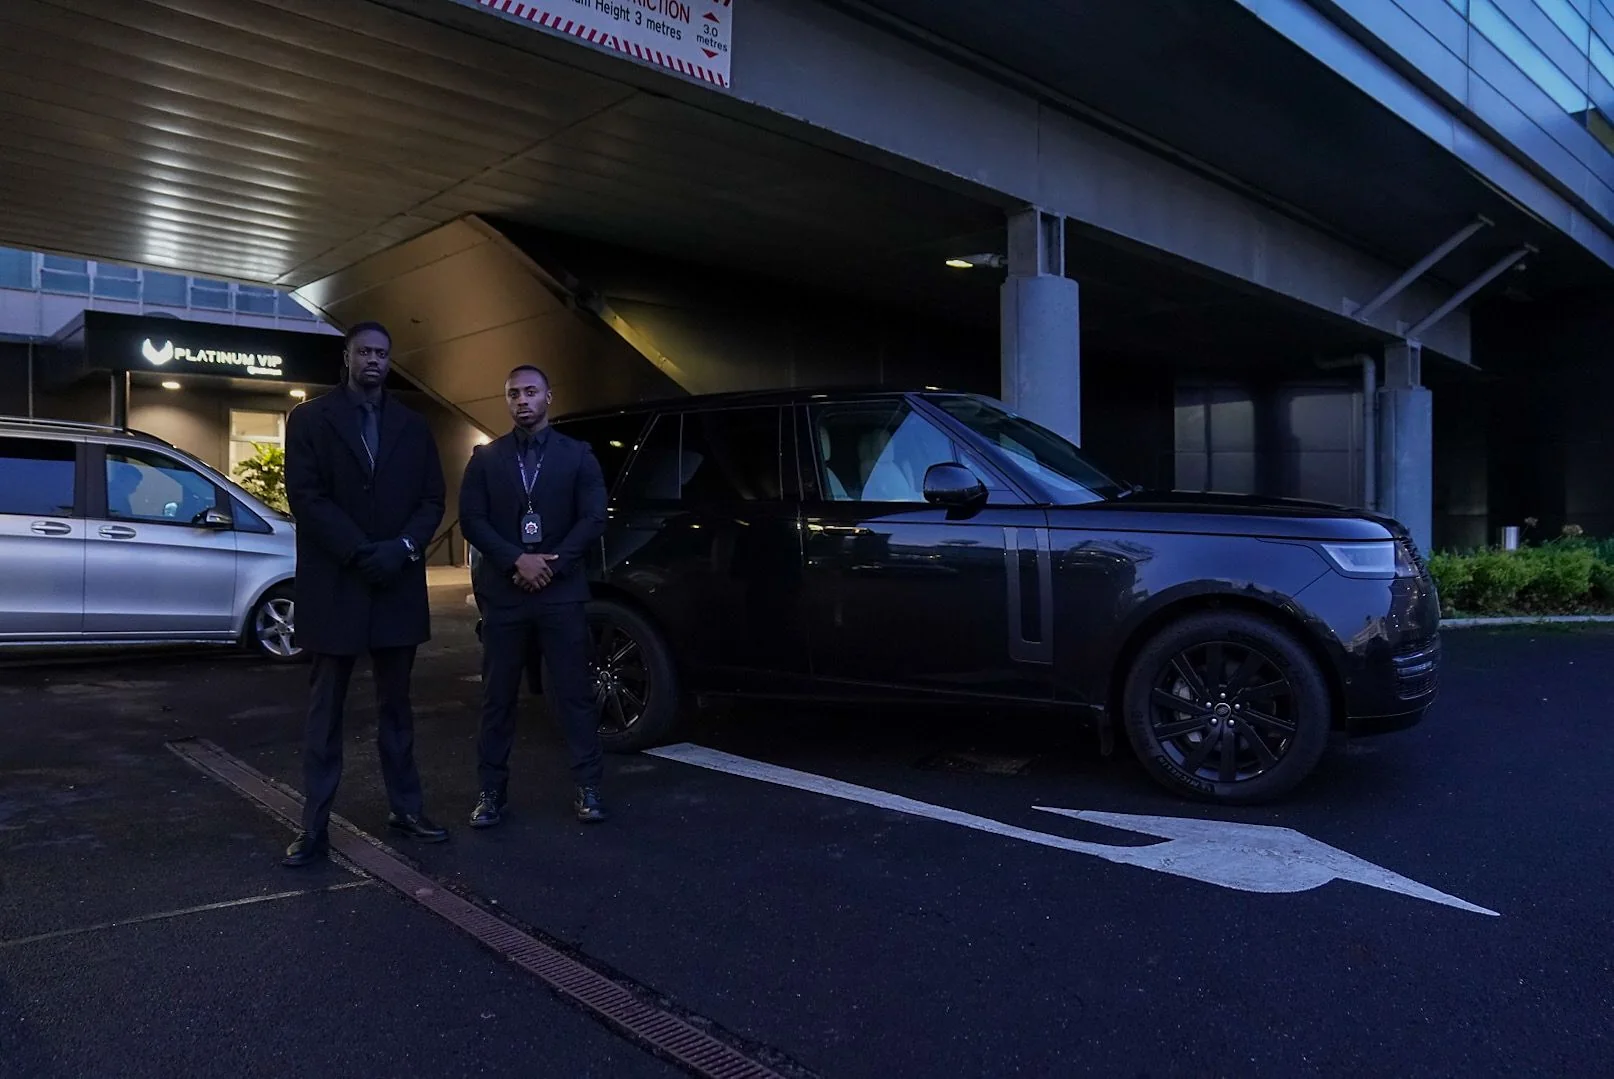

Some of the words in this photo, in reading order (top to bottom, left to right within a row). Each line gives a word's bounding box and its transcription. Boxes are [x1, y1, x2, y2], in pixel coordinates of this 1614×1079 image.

[595, 0, 630, 22] Height
[635, 11, 642, 26] 3
[646, 18, 682, 41] metres
[633, 0, 690, 24] CTION
[703, 24, 719, 38] 3.0
[696, 34, 728, 53] metres
[174, 347, 255, 366] PLATINUM
[257, 354, 283, 368] VIP
